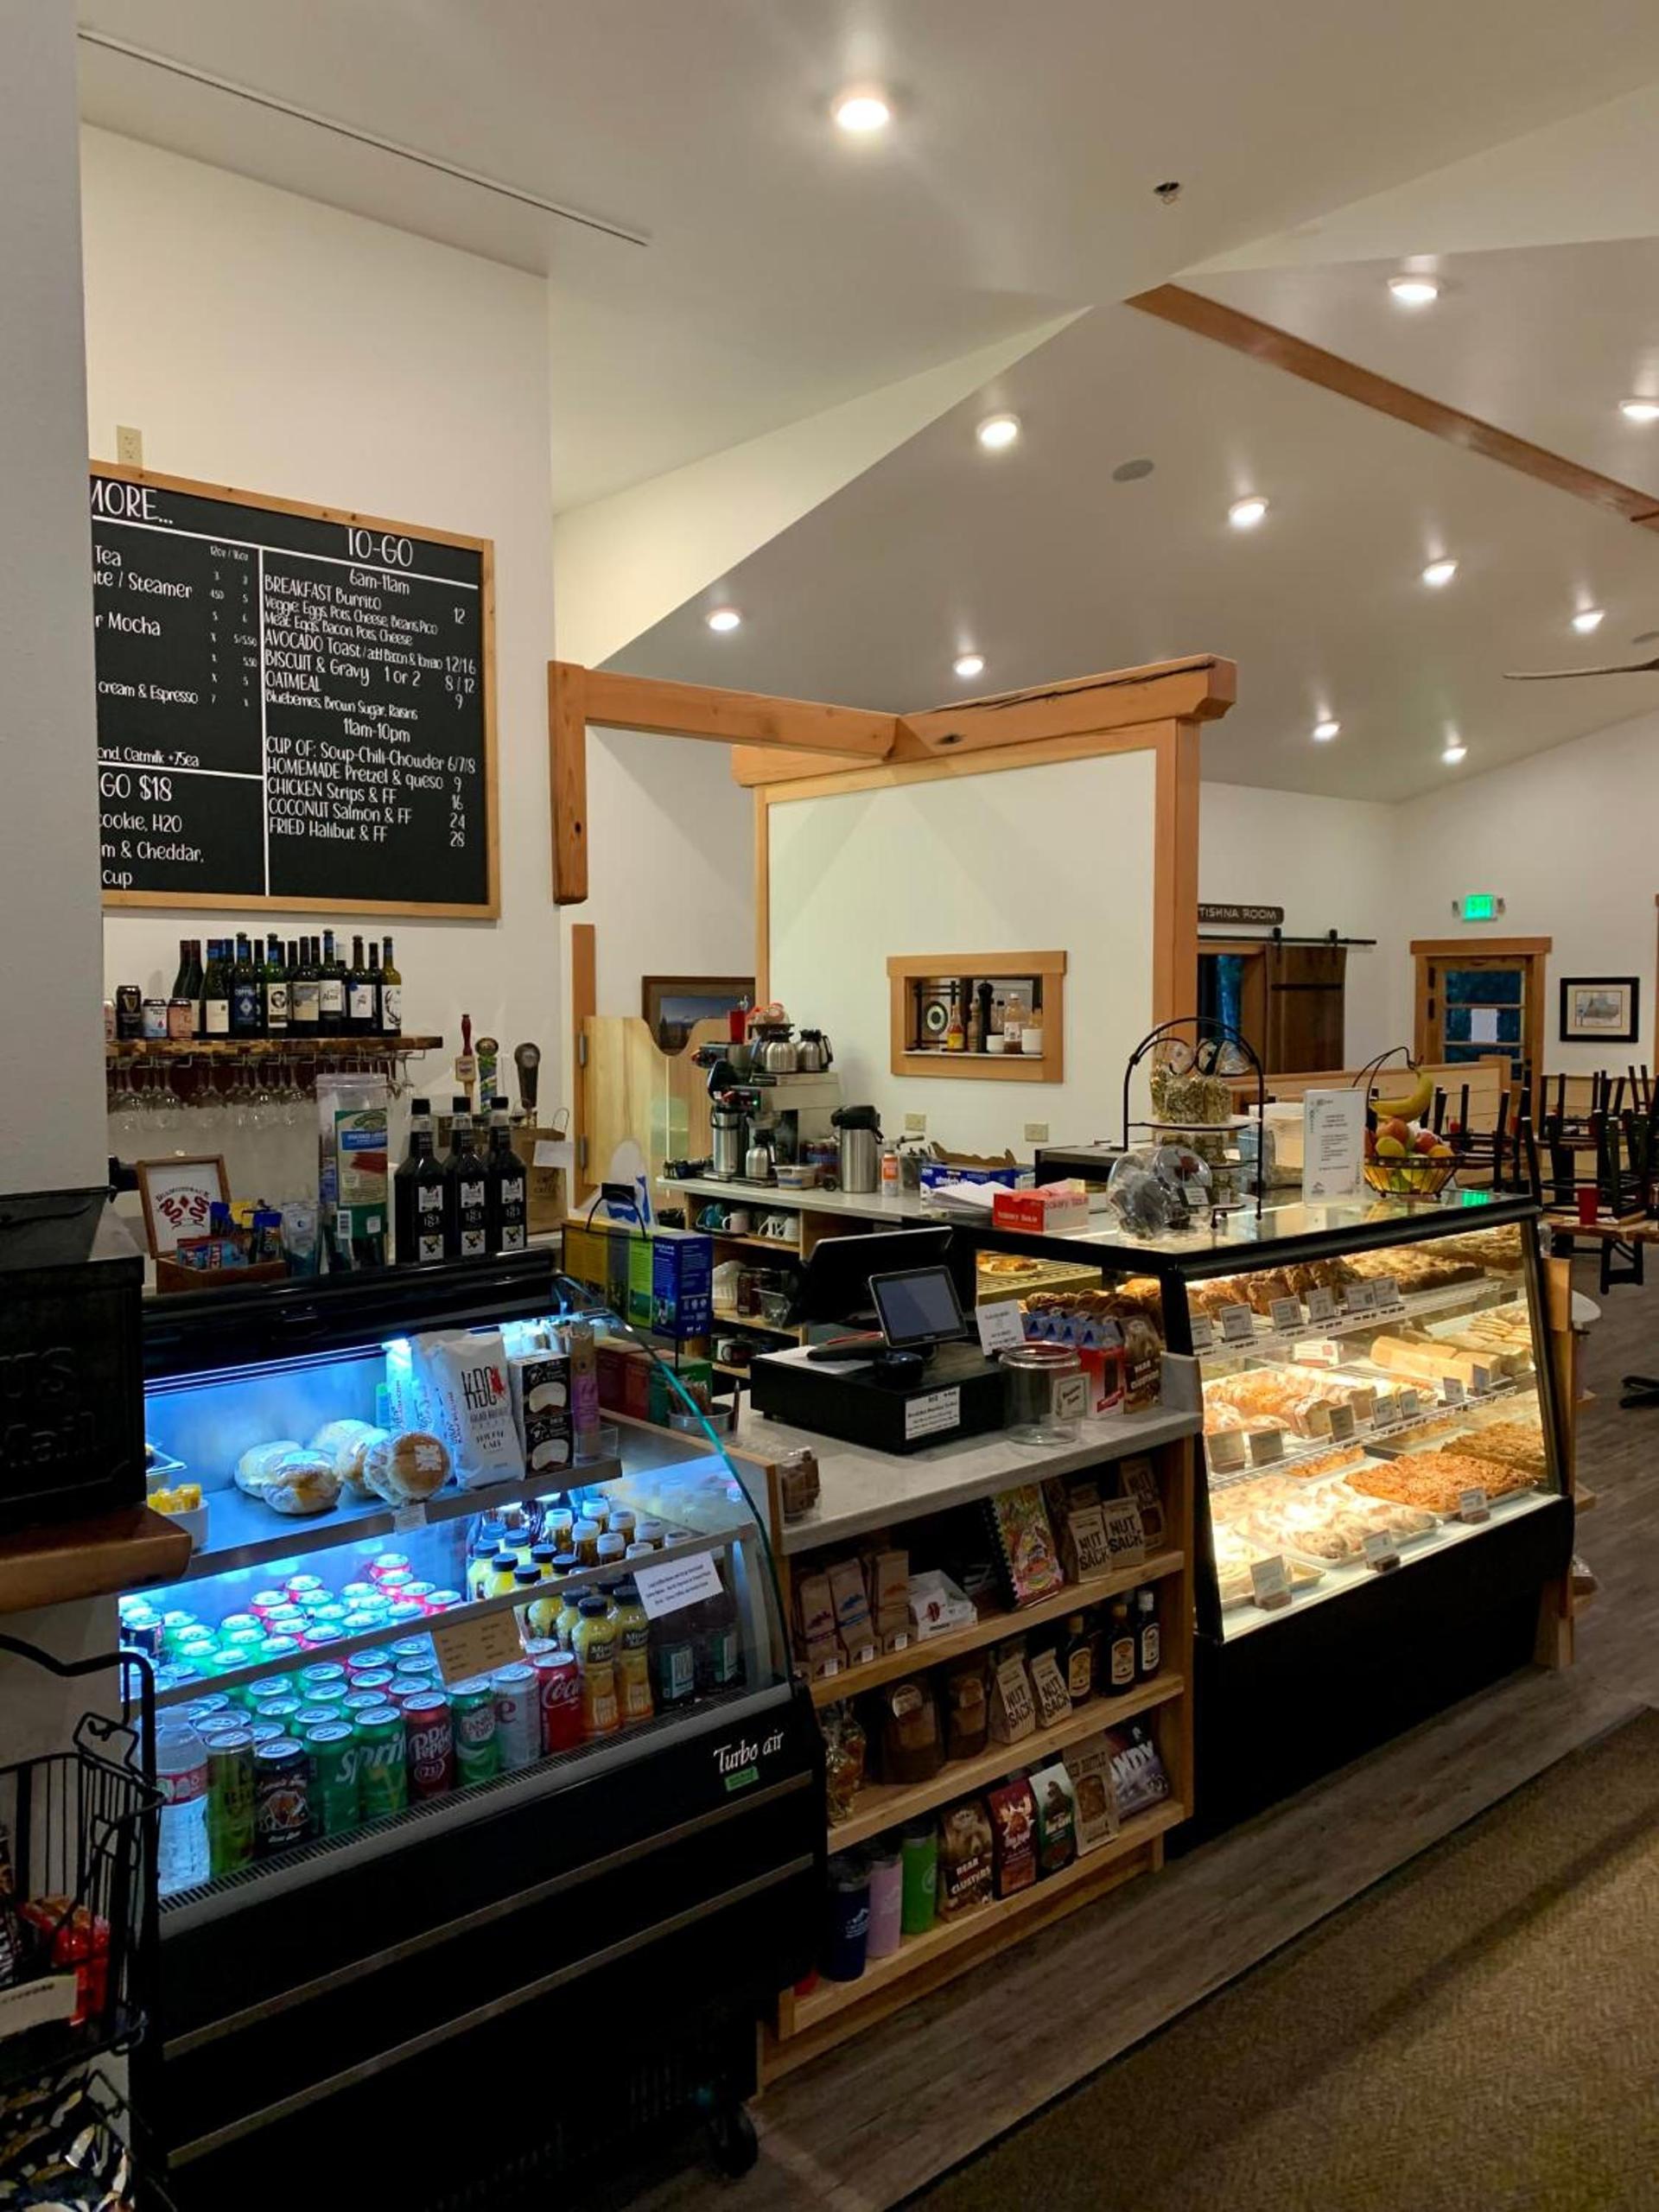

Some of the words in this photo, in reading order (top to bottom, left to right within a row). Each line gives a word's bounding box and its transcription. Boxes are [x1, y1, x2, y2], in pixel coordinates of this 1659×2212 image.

[95, 545, 122, 567] Tea
[348, 527, 414, 567] TO-GO
[129, 572, 193, 598] Steamer
[349, 568, 410, 594] 6am-11am
[264, 574, 332, 601] BREAKFAST
[335, 587, 382, 611] Burrito
[454, 607, 465, 624] 12
[108, 612, 162, 636] Mocha
[264, 628, 324, 653] AVOCADO
[327, 637, 362, 658] Toast
[446, 655, 476, 675] 12/16
[264, 648, 312, 671] BISCUIT
[315, 657, 327, 673] &
[330, 658, 370, 687] Gravy
[385, 665, 391, 683] 1
[393, 671, 409, 684] or
[412, 671, 422, 687] 2
[138, 683, 148, 698] &
[150, 685, 199, 704] Espresso
[265, 670, 322, 693] OATMEAL
[454, 693, 464, 710] 9
[323, 696, 357, 713] Brown
[343, 718, 410, 743] 11am-10pm
[266, 735, 292, 755] CUP
[296, 739, 317, 758] OF:
[100, 772, 130, 798] GO
[139, 774, 172, 802] $18
[267, 757, 342, 780] HOMEMADE
[345, 765, 390, 785] Pretzel
[391, 769, 402, 785] &
[404, 773, 444, 791] queso
[454, 776, 462, 793] 9
[267, 776, 323, 797] CHICKEN
[326, 782, 365, 804] Strips
[368, 786, 378, 804] &
[382, 787, 397, 804] FF
[451, 794, 464, 810] 16
[269, 798, 329, 819] COCONUT
[332, 802, 381, 822] Salmon
[384, 806, 395, 824] &
[397, 807, 413, 824] FF
[449, 812, 466, 830] 24
[269, 816, 306, 836] FRIED
[308, 820, 357, 841] Halibut
[359, 823, 370, 842] &
[373, 825, 388, 843] FF
[449, 830, 466, 848] 28
[121, 840, 132, 859] &
[1242, 908, 1277, 921] ROOM
[1109, 1516, 1135, 1535] NUT
[1078, 1532, 1102, 1554] NUT
[1108, 1535, 1142, 1553] SACK
[1078, 1549, 1109, 1571] SACK
[1006, 1686, 1027, 1707] NUT
[1042, 1676, 1060, 1700] NUT
[1007, 1700, 1035, 1728] SACK
[1044, 1694, 1069, 1719] SACK
[713, 1739, 759, 1774] Turbo
[762, 1729, 785, 1756] air
[957, 1858, 979, 1874] BEAR
